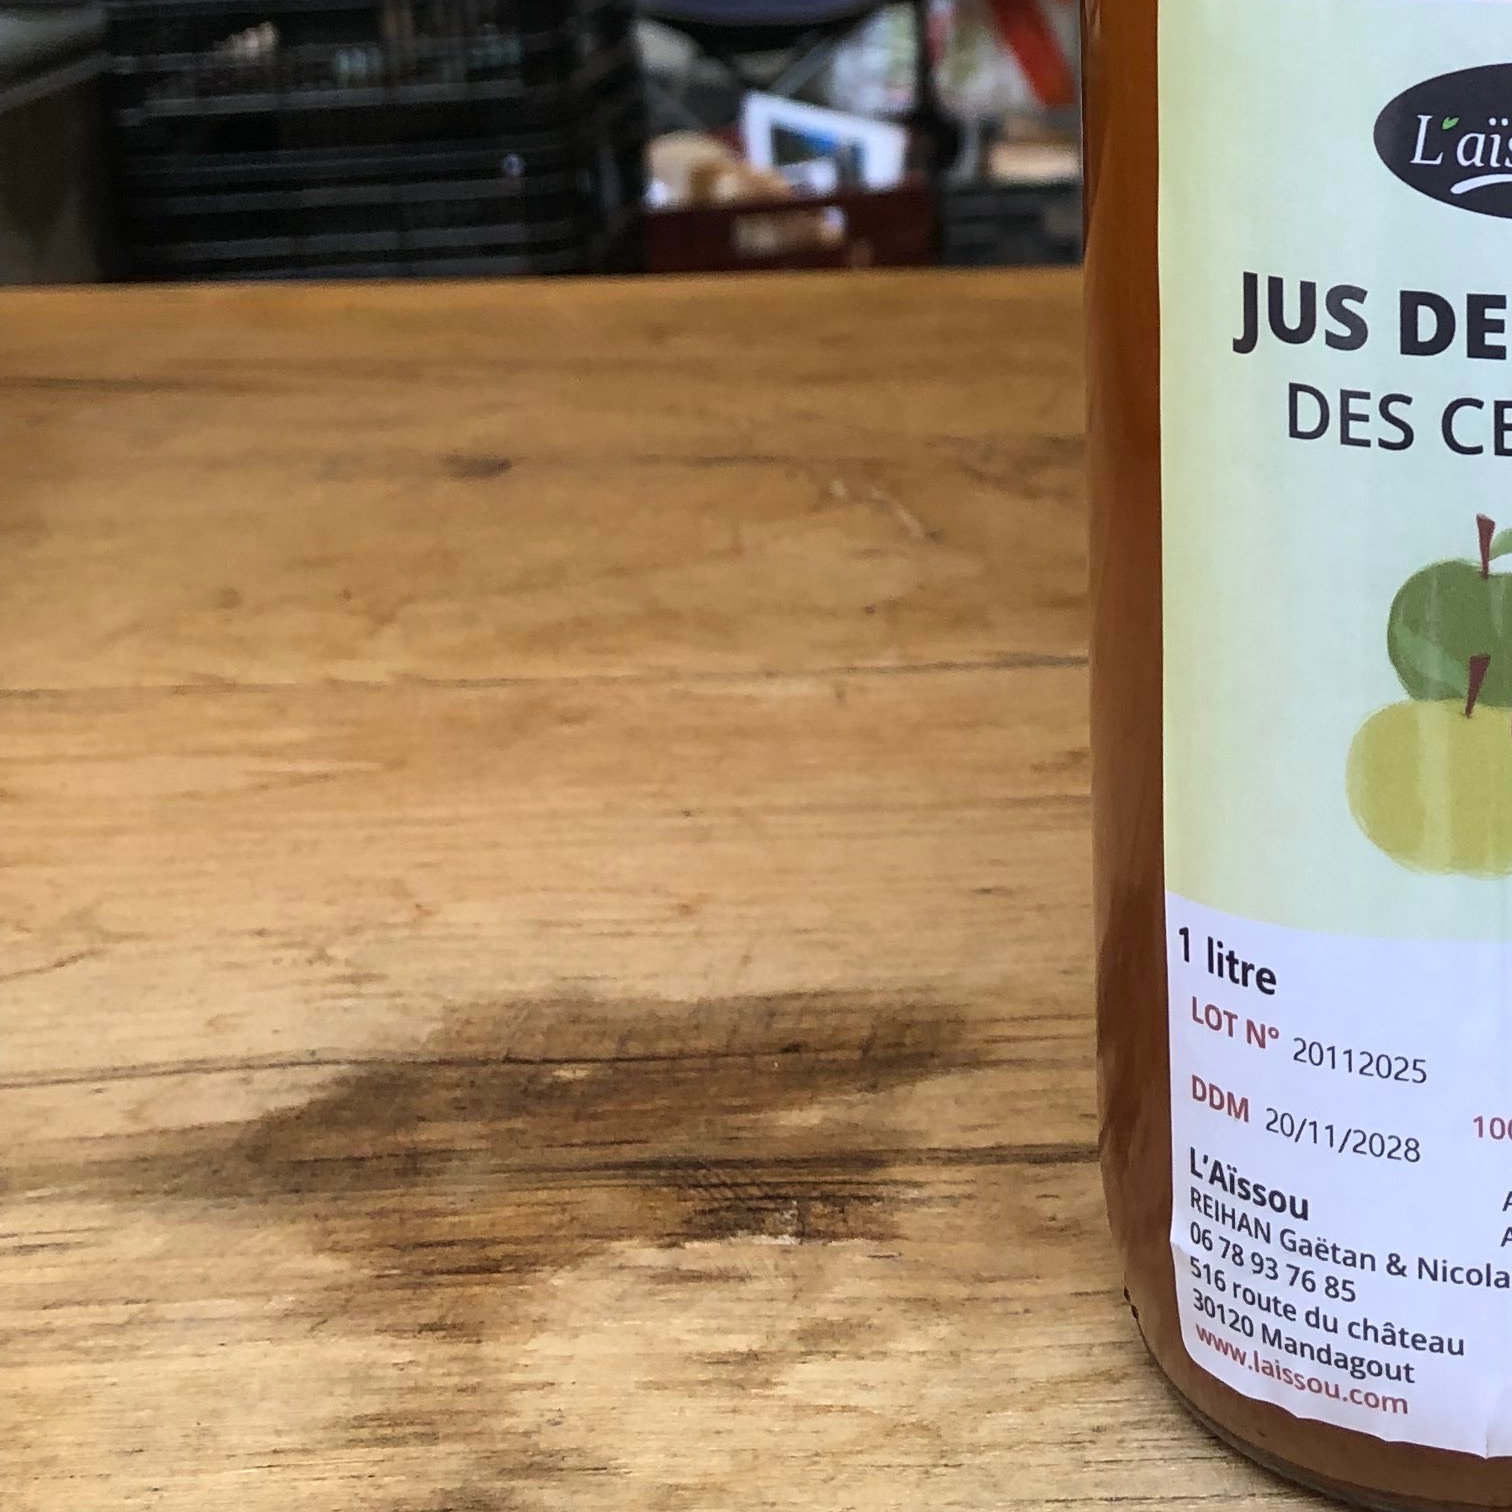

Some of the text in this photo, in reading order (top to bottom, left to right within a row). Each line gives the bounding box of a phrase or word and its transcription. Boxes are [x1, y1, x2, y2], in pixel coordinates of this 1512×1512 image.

[1233, 271, 1368, 355] JUS
[1400, 290, 1507, 361] DE
[1288, 381, 1414, 453] DES
[1179, 927, 1277, 997] 1 litre
[1191, 996, 1428, 1084] LOT N° 20112025
[1191, 1074, 1421, 1163] DDM 20/11/2028
[1190, 1186, 1272, 1244] REIHAN
[1280, 1227, 1377, 1273] Gaëtan
[1386, 1253, 1407, 1278] &
[1190, 1221, 1356, 1303] 06 78 93 76 85
[1190, 1256, 1465, 1357] 516 route du château
[1193, 1288, 1417, 1385] 30120 Mandagout
[1195, 1323, 1409, 1416] www.laissou.com
